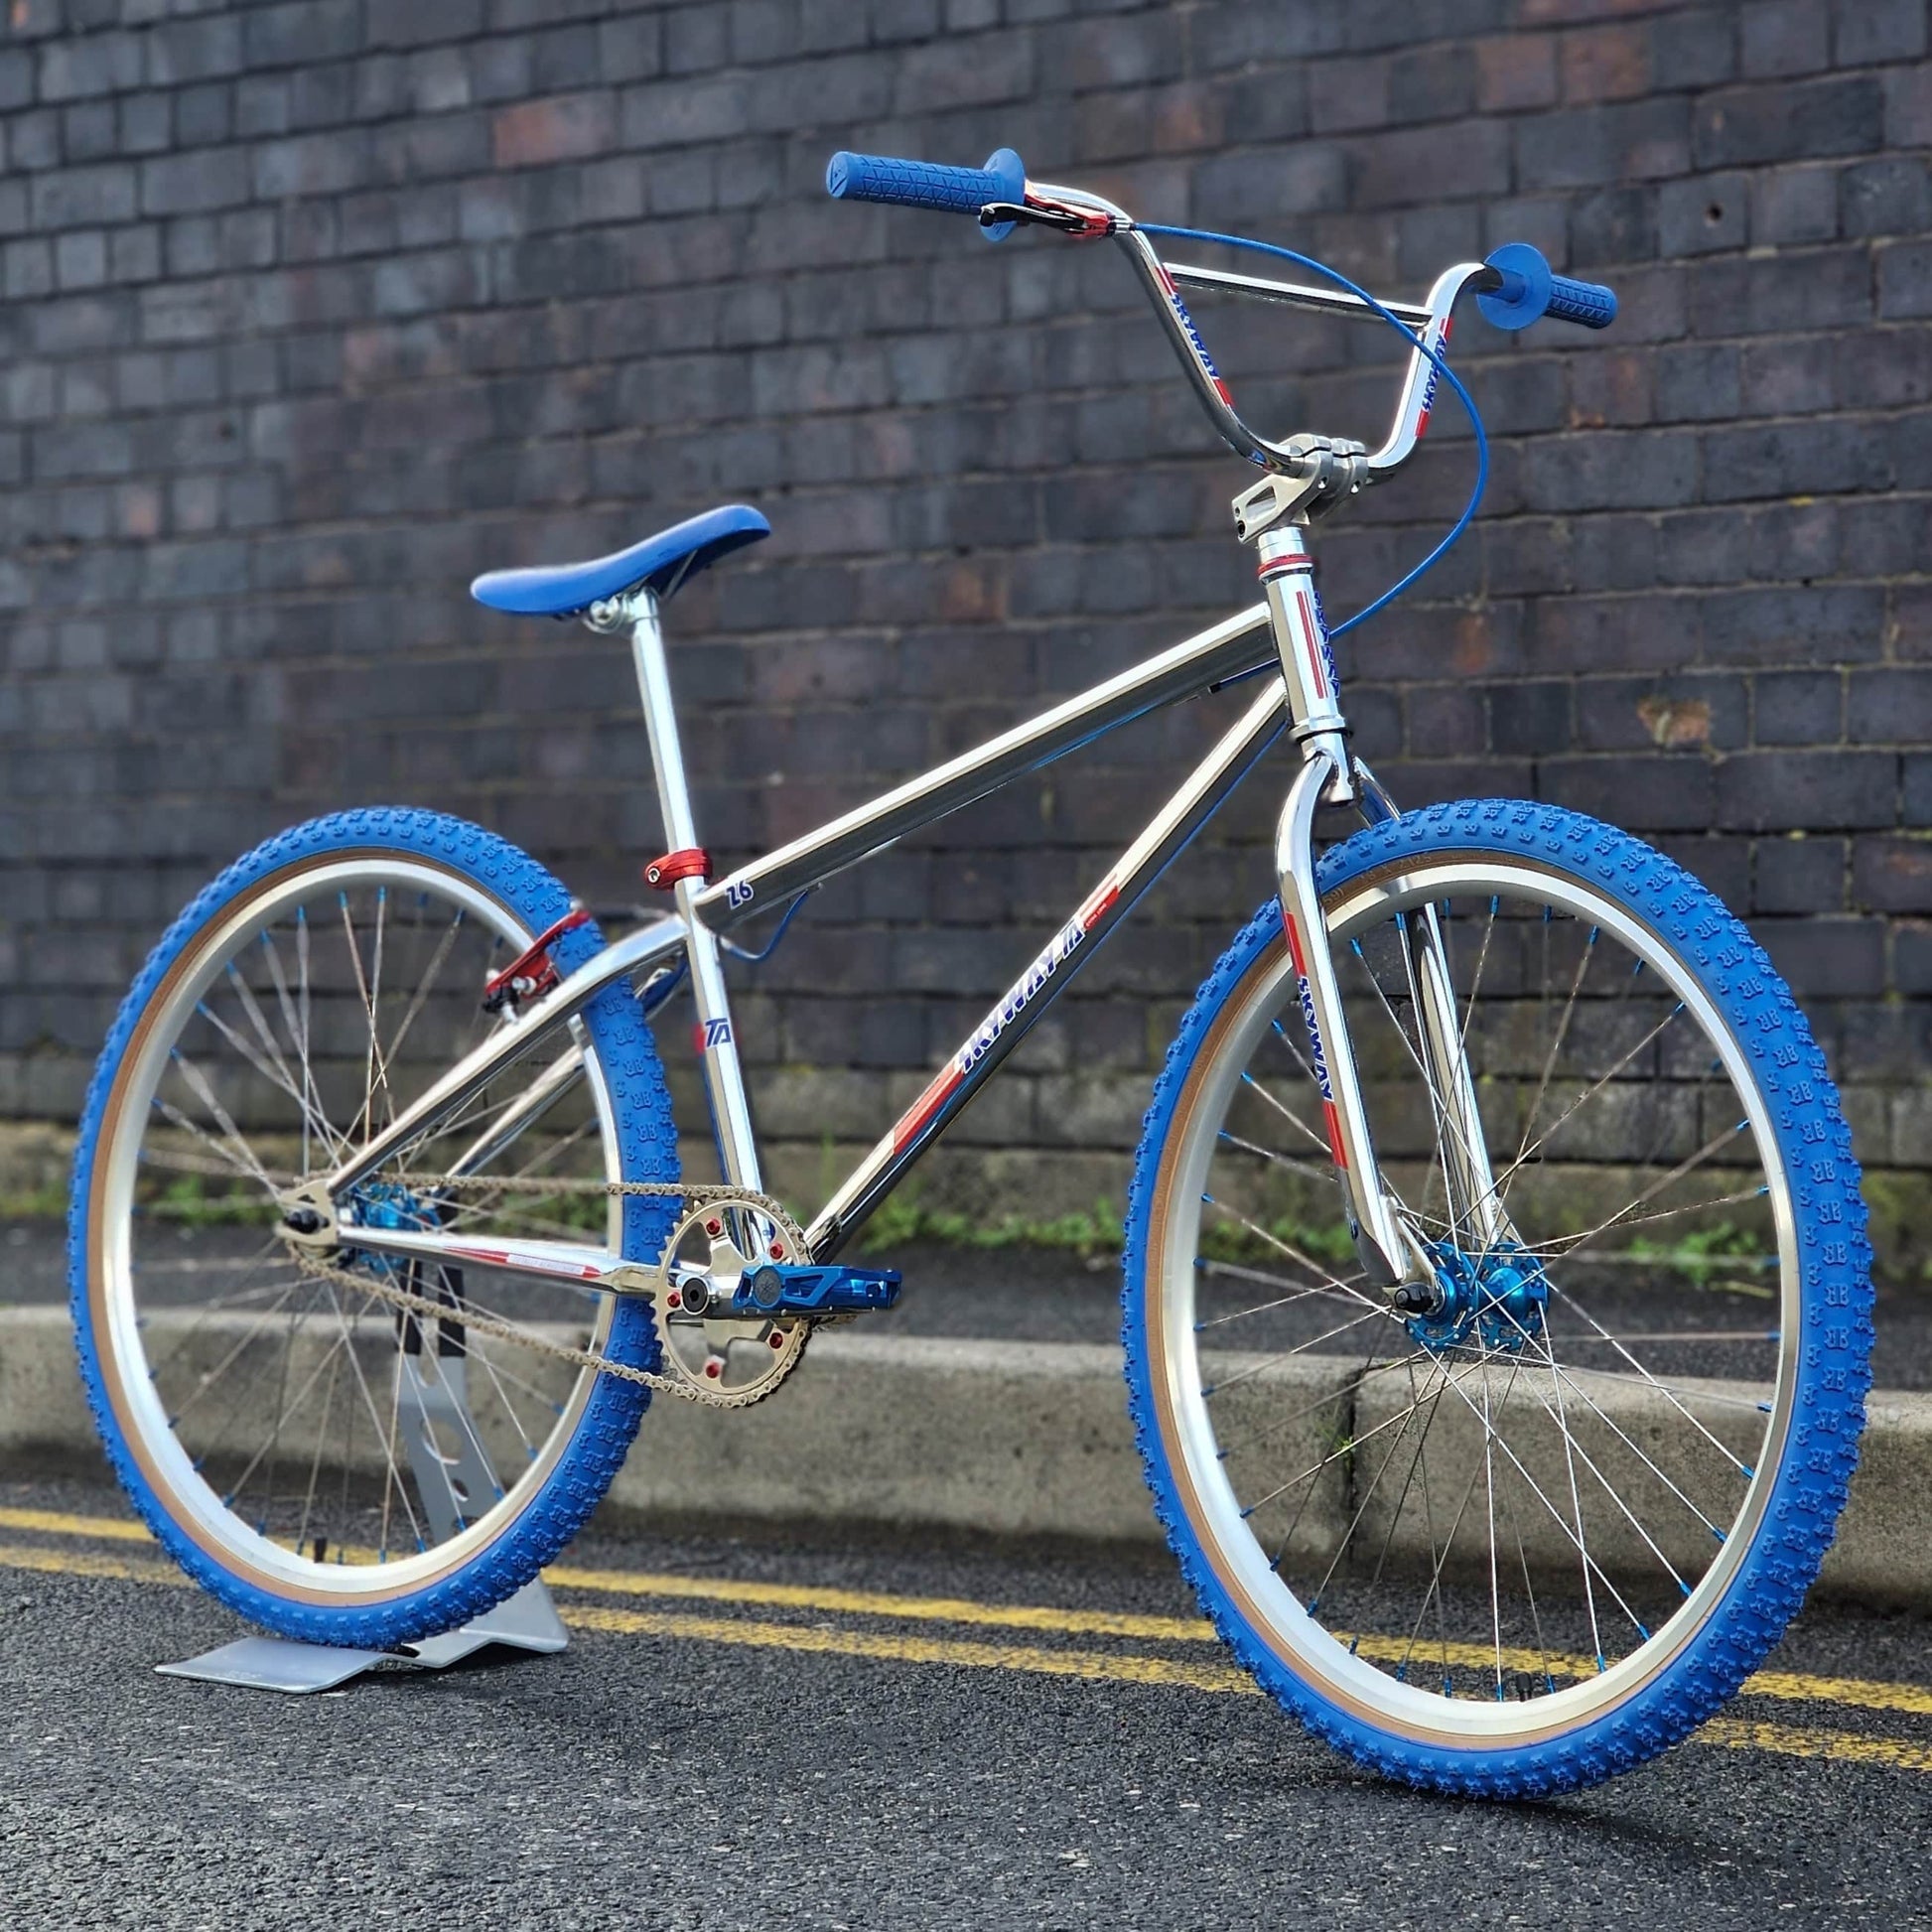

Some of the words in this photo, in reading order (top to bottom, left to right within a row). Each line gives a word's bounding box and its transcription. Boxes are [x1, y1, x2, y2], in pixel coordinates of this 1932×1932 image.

[726, 881, 754, 909] 26
[705, 1018, 732, 1048] TA
[956, 944, 1056, 1074] SKYWAY
[1297, 976, 1333, 1101] SKYWAY
